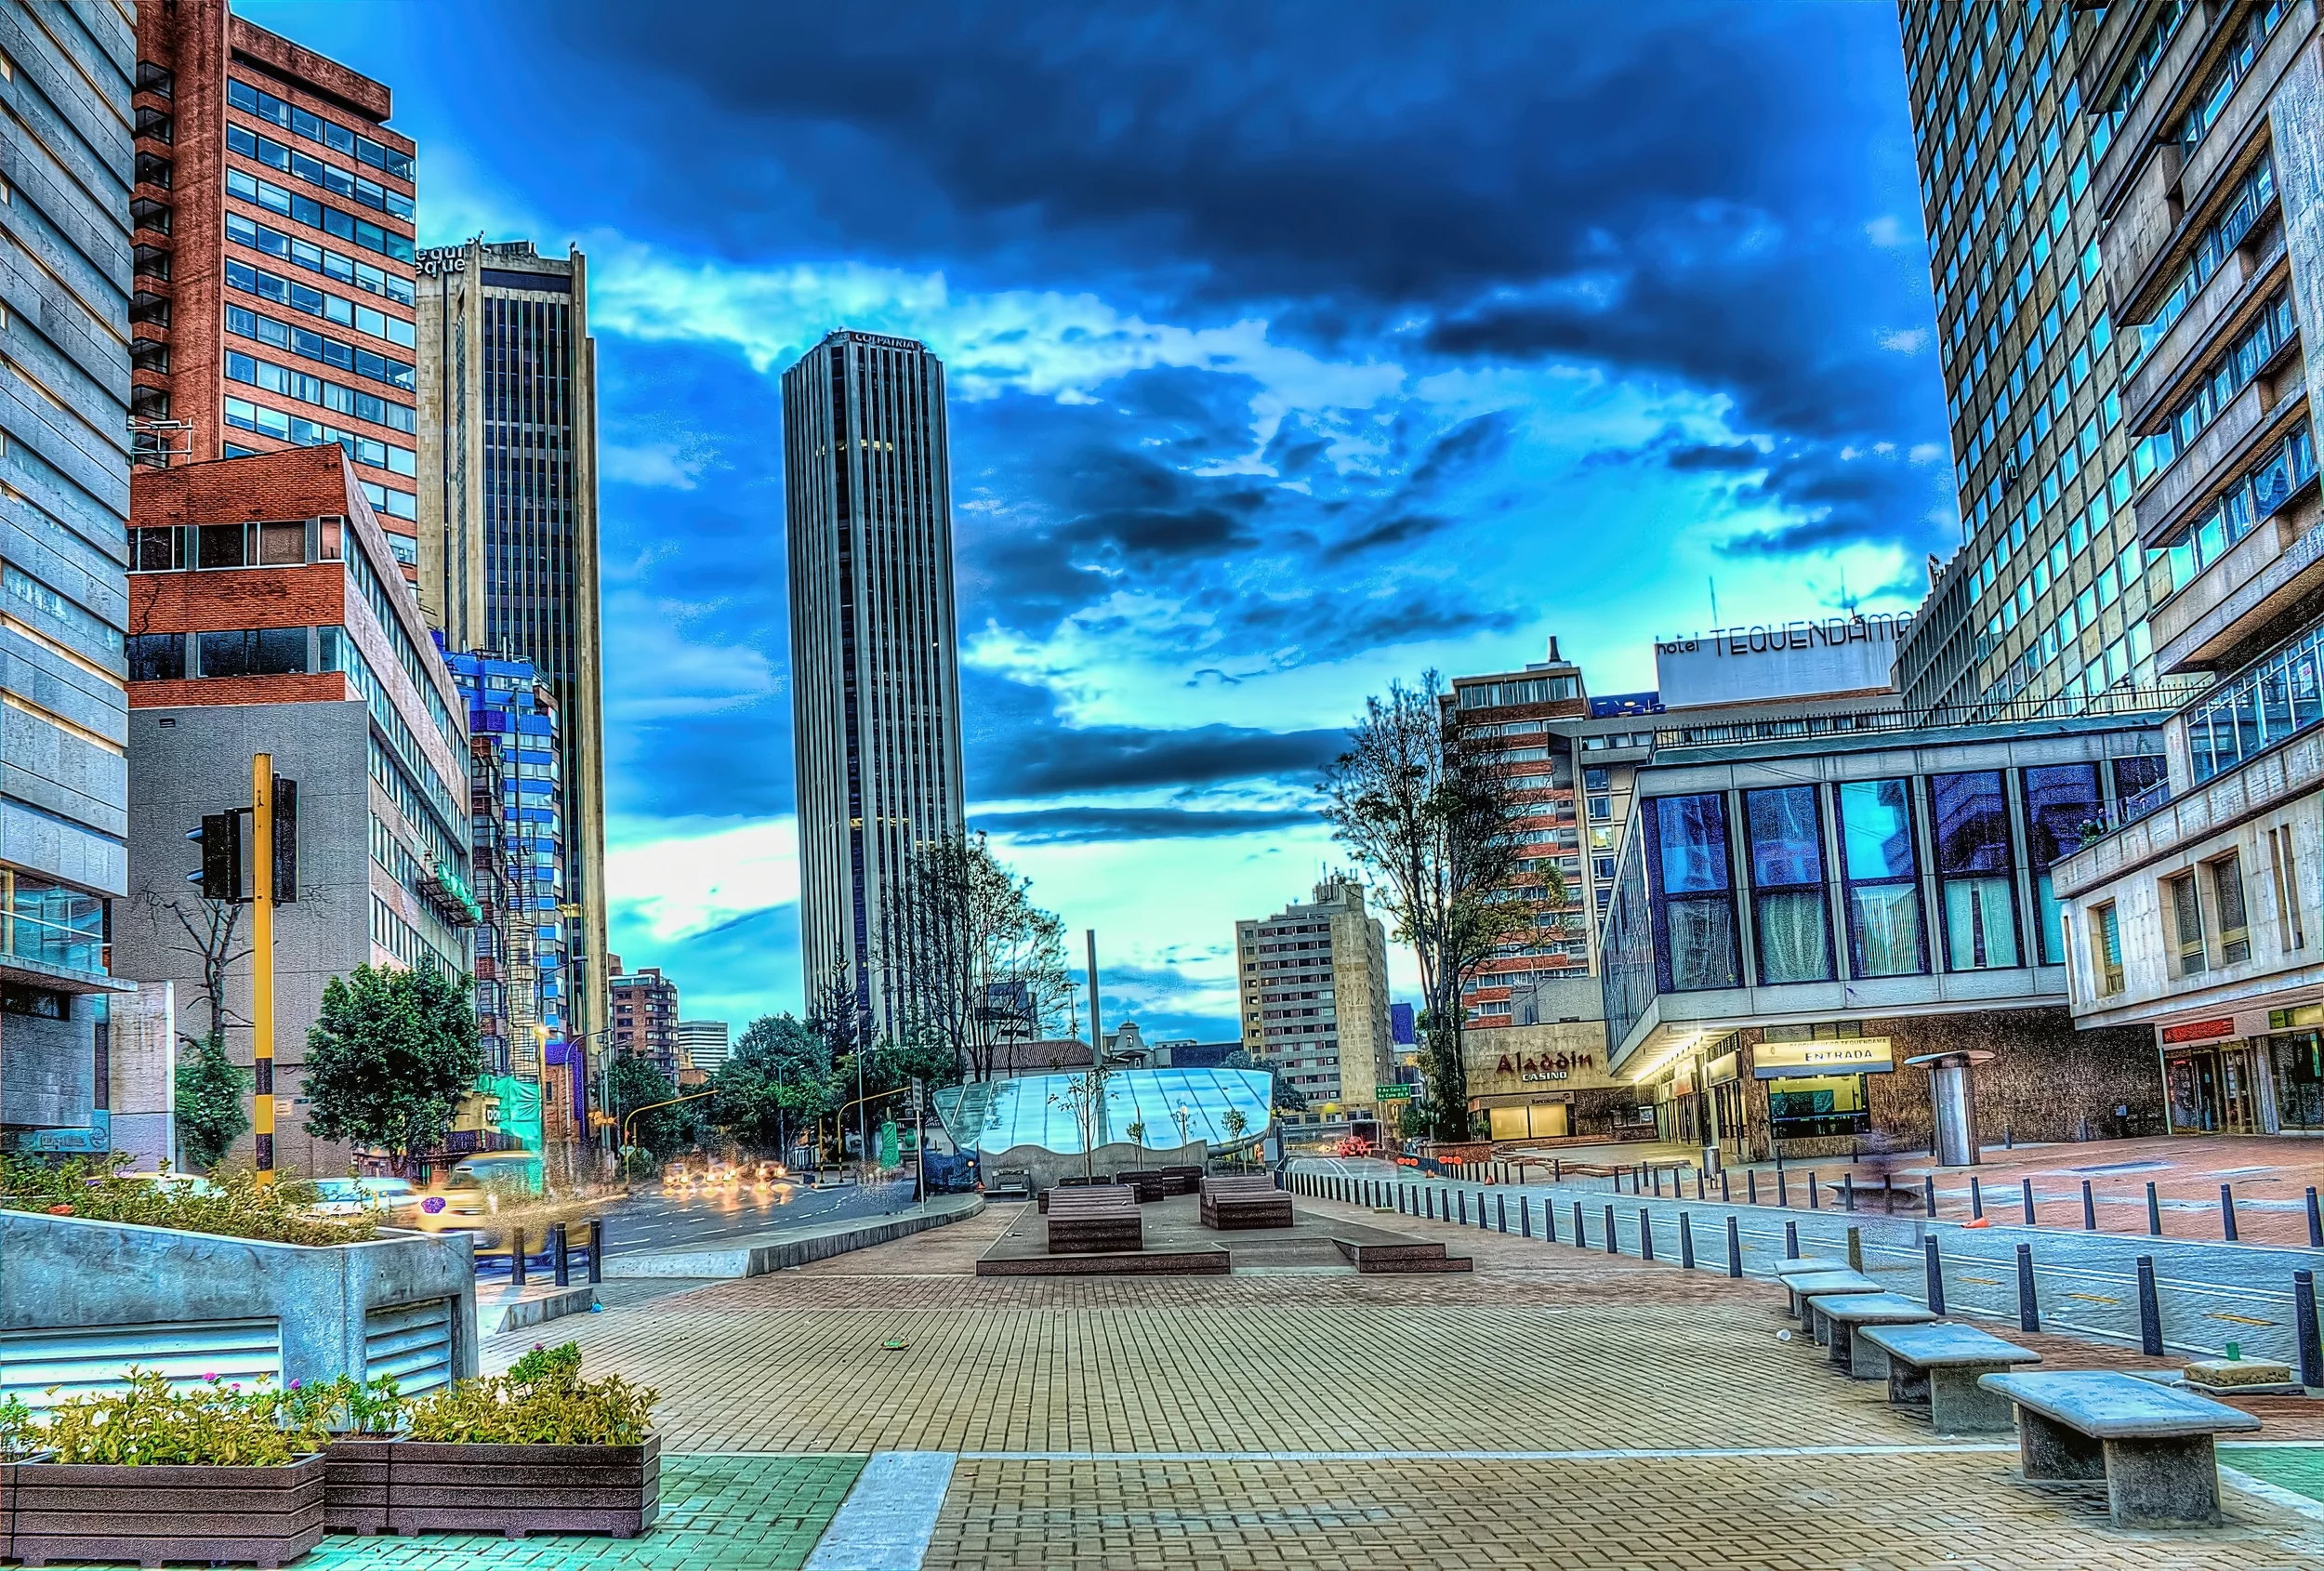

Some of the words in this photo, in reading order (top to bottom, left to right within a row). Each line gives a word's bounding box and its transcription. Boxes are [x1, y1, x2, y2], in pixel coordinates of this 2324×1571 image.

[855, 333, 915, 350] COLPATRIA
[1655, 631, 1699, 655] hotel
[1496, 1050, 1593, 1075] Aladdin
[1805, 1050, 1873, 1062] ENTRADA
[1522, 1071, 1567, 1082] CASINO
